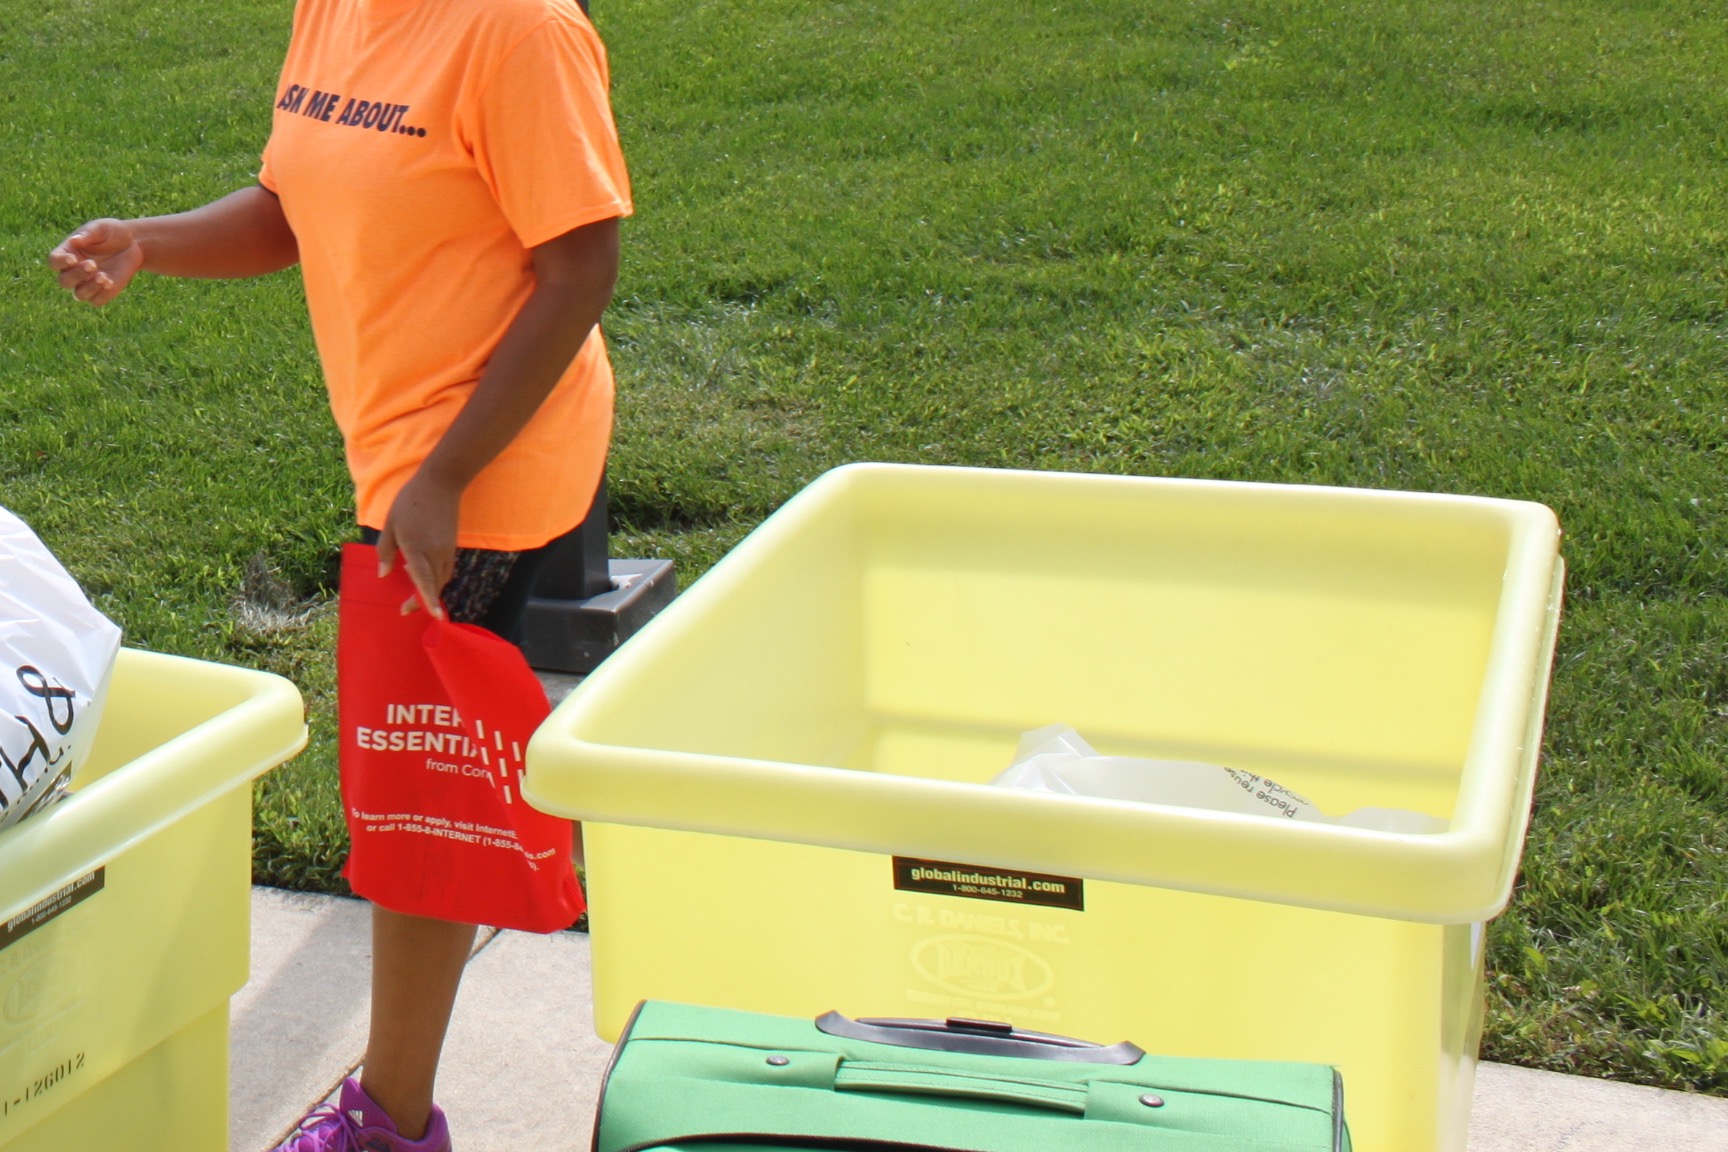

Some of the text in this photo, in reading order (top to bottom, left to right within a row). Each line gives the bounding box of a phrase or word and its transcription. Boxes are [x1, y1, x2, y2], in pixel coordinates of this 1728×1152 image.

[302, 90, 341, 122] ME
[335, 98, 427, 137] ABOUT...
[15, 664, 77, 736] &
[425, 758, 459, 775] from
[1255, 789, 1299, 819] Please
[361, 811, 385, 821] learn
[387, 813, 410, 821] more
[412, 814, 424, 822] or
[454, 819, 474, 832] visit
[366, 824, 377, 832] or
[378, 823, 395, 832] call
[911, 866, 1066, 894] globalindustrial.com
[952, 883, 1024, 899] 1-800-645-1232
